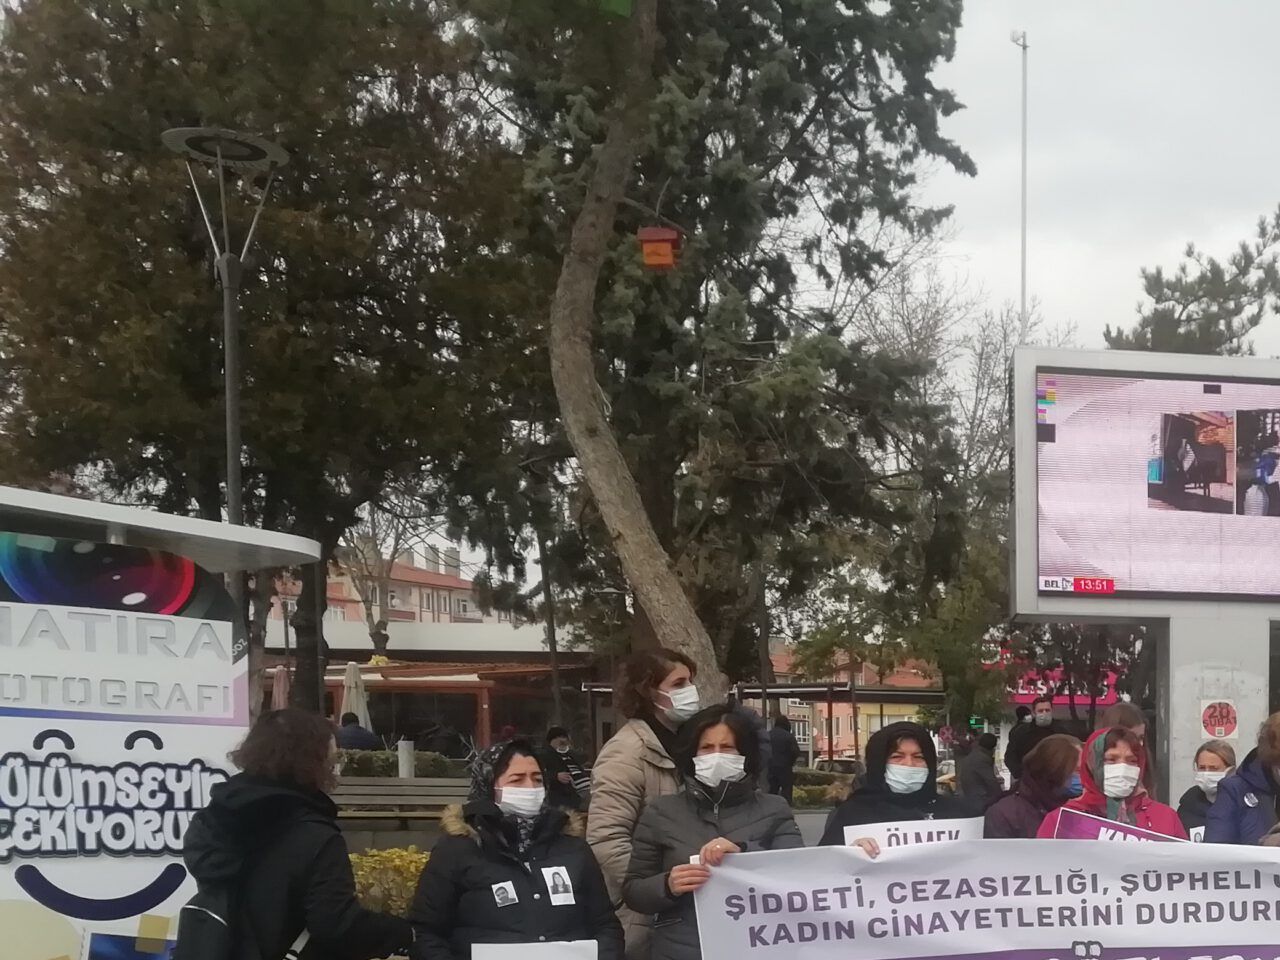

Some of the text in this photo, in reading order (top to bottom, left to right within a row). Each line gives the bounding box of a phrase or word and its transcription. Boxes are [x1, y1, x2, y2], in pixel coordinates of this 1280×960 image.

[1044, 580, 1061, 589] BEL
[1080, 579, 1107, 590] 13:51
[0, 606, 230, 660] ATIRA
[1208, 702, 1231, 719] 20
[724, 877, 876, 920] ŞİDDETİ,
[887, 867, 1110, 905] CEZASIZLIĞI,
[748, 920, 856, 947] KADIN
[867, 897, 1123, 939] CİNAYETLERİNİ
